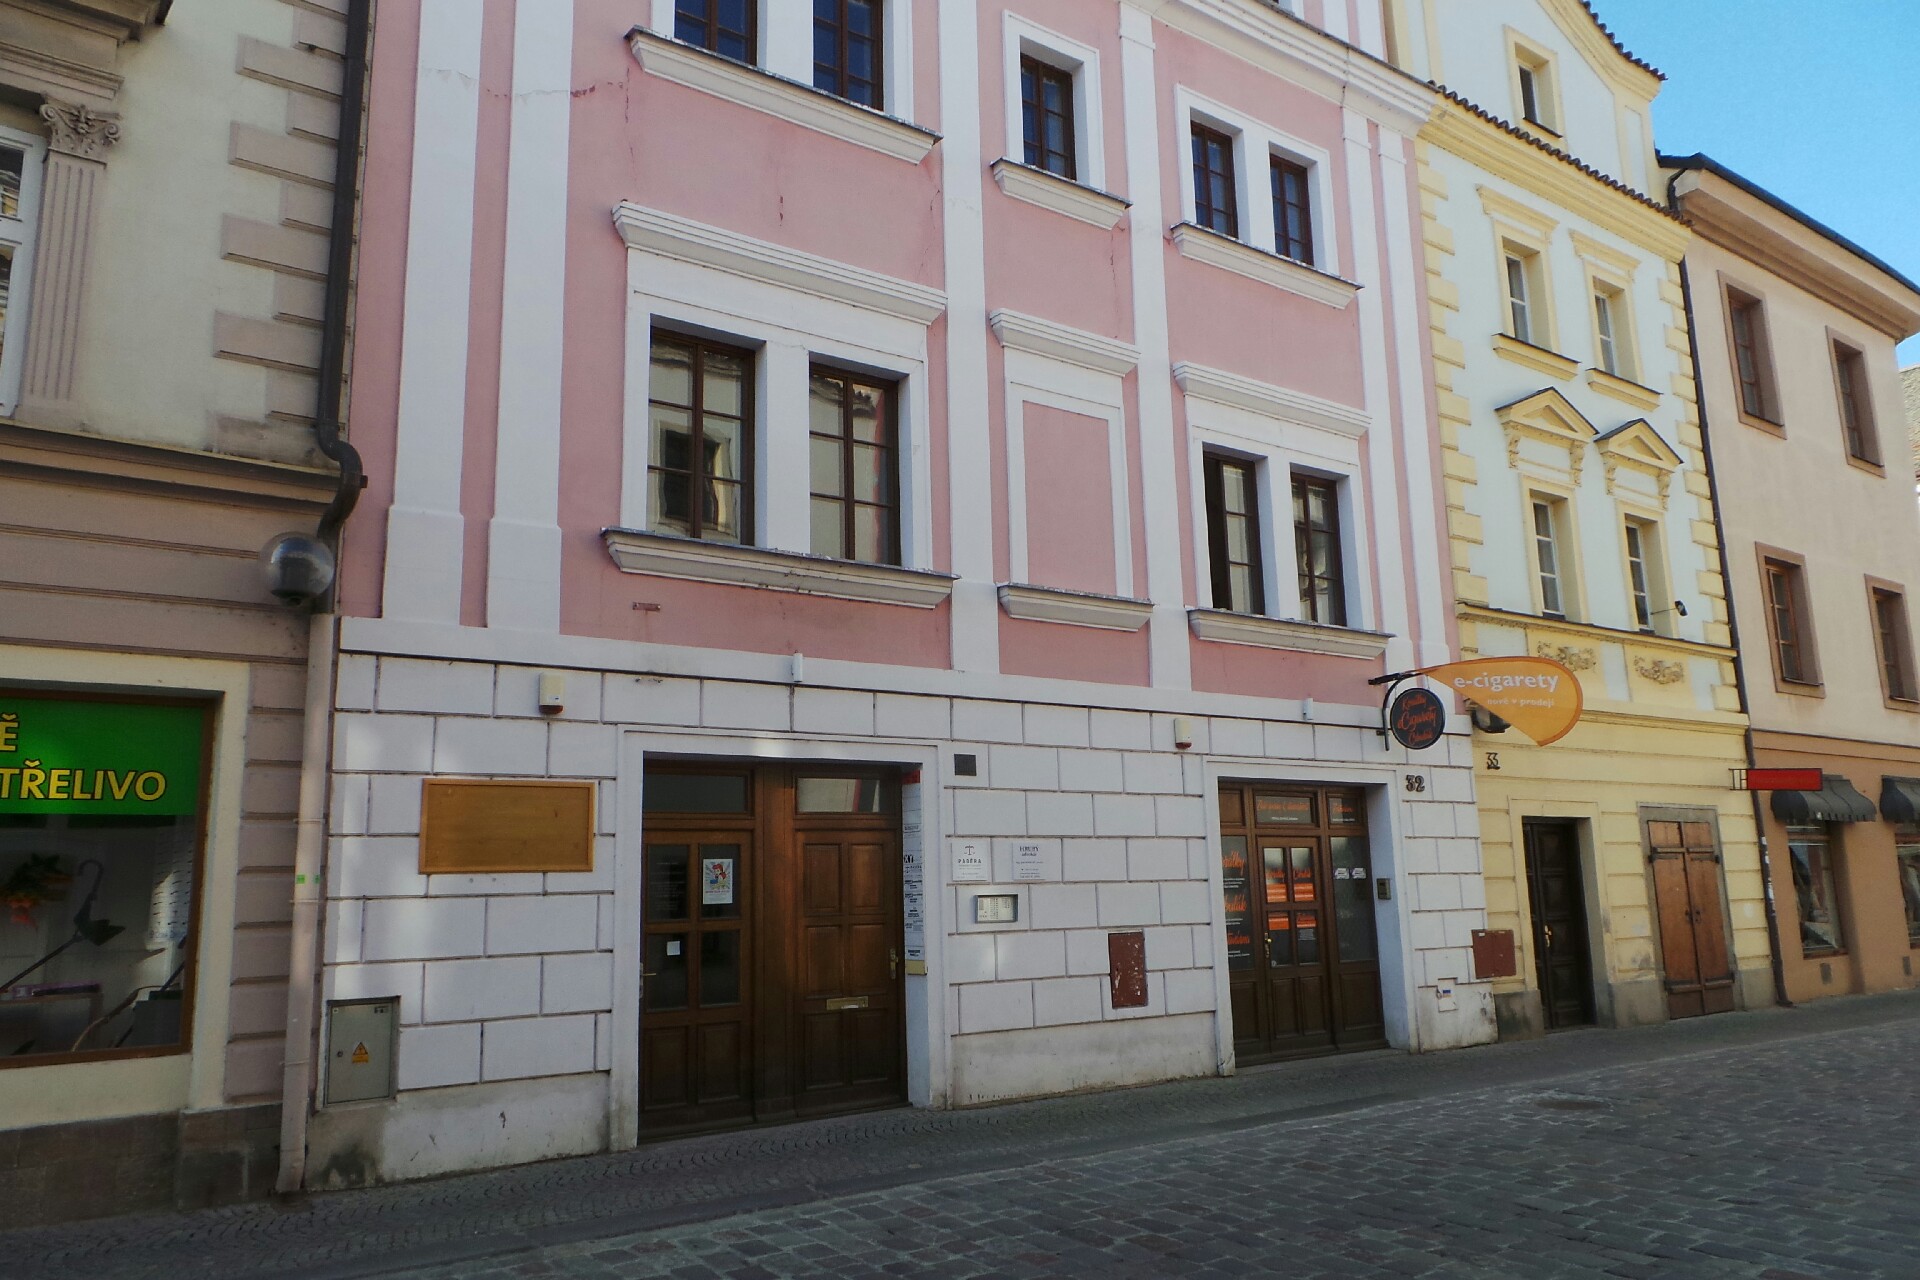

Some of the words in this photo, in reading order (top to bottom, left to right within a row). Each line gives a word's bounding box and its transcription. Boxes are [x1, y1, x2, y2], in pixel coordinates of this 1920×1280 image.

[1453, 672, 1559, 693] e-cigarety
[1485, 752, 1501, 770] 33
[0, 759, 167, 801] TŘELIVO
[1406, 774, 1425, 793] 32
